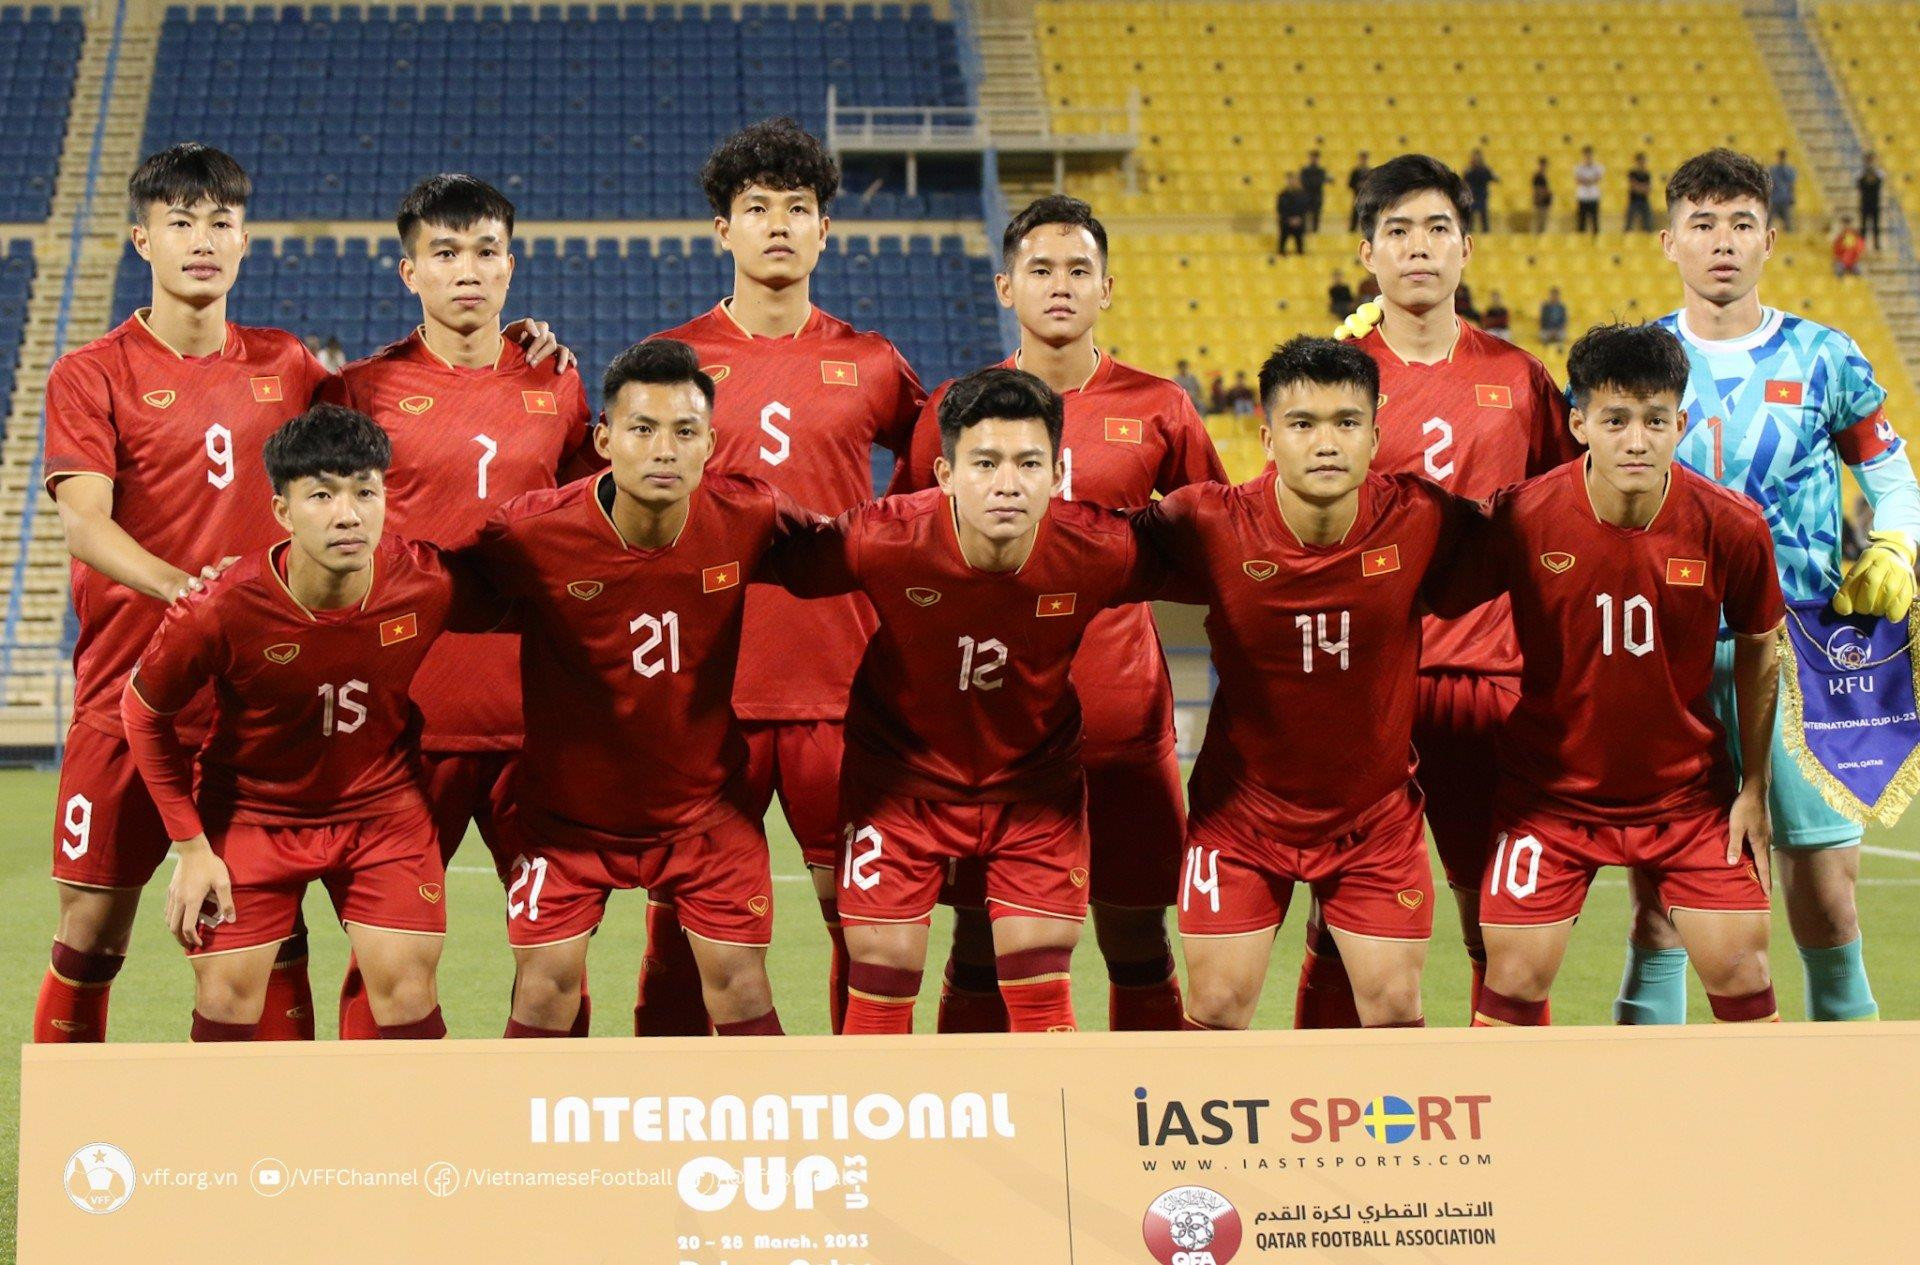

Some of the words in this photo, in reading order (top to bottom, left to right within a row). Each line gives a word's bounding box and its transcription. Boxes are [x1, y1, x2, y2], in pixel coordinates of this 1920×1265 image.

[204, 422, 235, 490] 9
[759, 400, 792, 467] 5
[1421, 416, 1455, 483] 2
[1706, 416, 1725, 480] 1
[469, 432, 498, 500] 7
[629, 610, 680, 679] 21
[1295, 610, 1350, 674] 14
[1596, 592, 1655, 657] 10
[957, 635, 1009, 691] 12
[1828, 675, 1874, 695] KFU
[317, 678, 369, 736] 15
[1871, 715, 1891, 727] CUP
[1892, 711, 1917, 723] U-23
[1860, 759, 1884, 768] QATAR
[61, 793, 93, 861] 9
[842, 822, 882, 891] 12
[1182, 844, 1220, 913] 14
[1490, 832, 1544, 900] 10
[508, 853, 548, 921] 21
[530, 1092, 1016, 1144] INTERNATIONAL
[677, 1154, 839, 1212] CUP
[843, 1154, 869, 1210] U-23
[1434, 1201, 1494, 1218] الاتحاد
[1254, 1204, 1307, 1225] القدم
[1256, 1231, 1308, 1251] QATAR
[1311, 1230, 1391, 1248] FOOTBALL
[1395, 1228, 1496, 1247] ASSOCIATION
[1312, 1203, 1351, 1224] لكرة
[1357, 1202, 1428, 1224] القطري
[677, 1235, 701, 1251] 20
